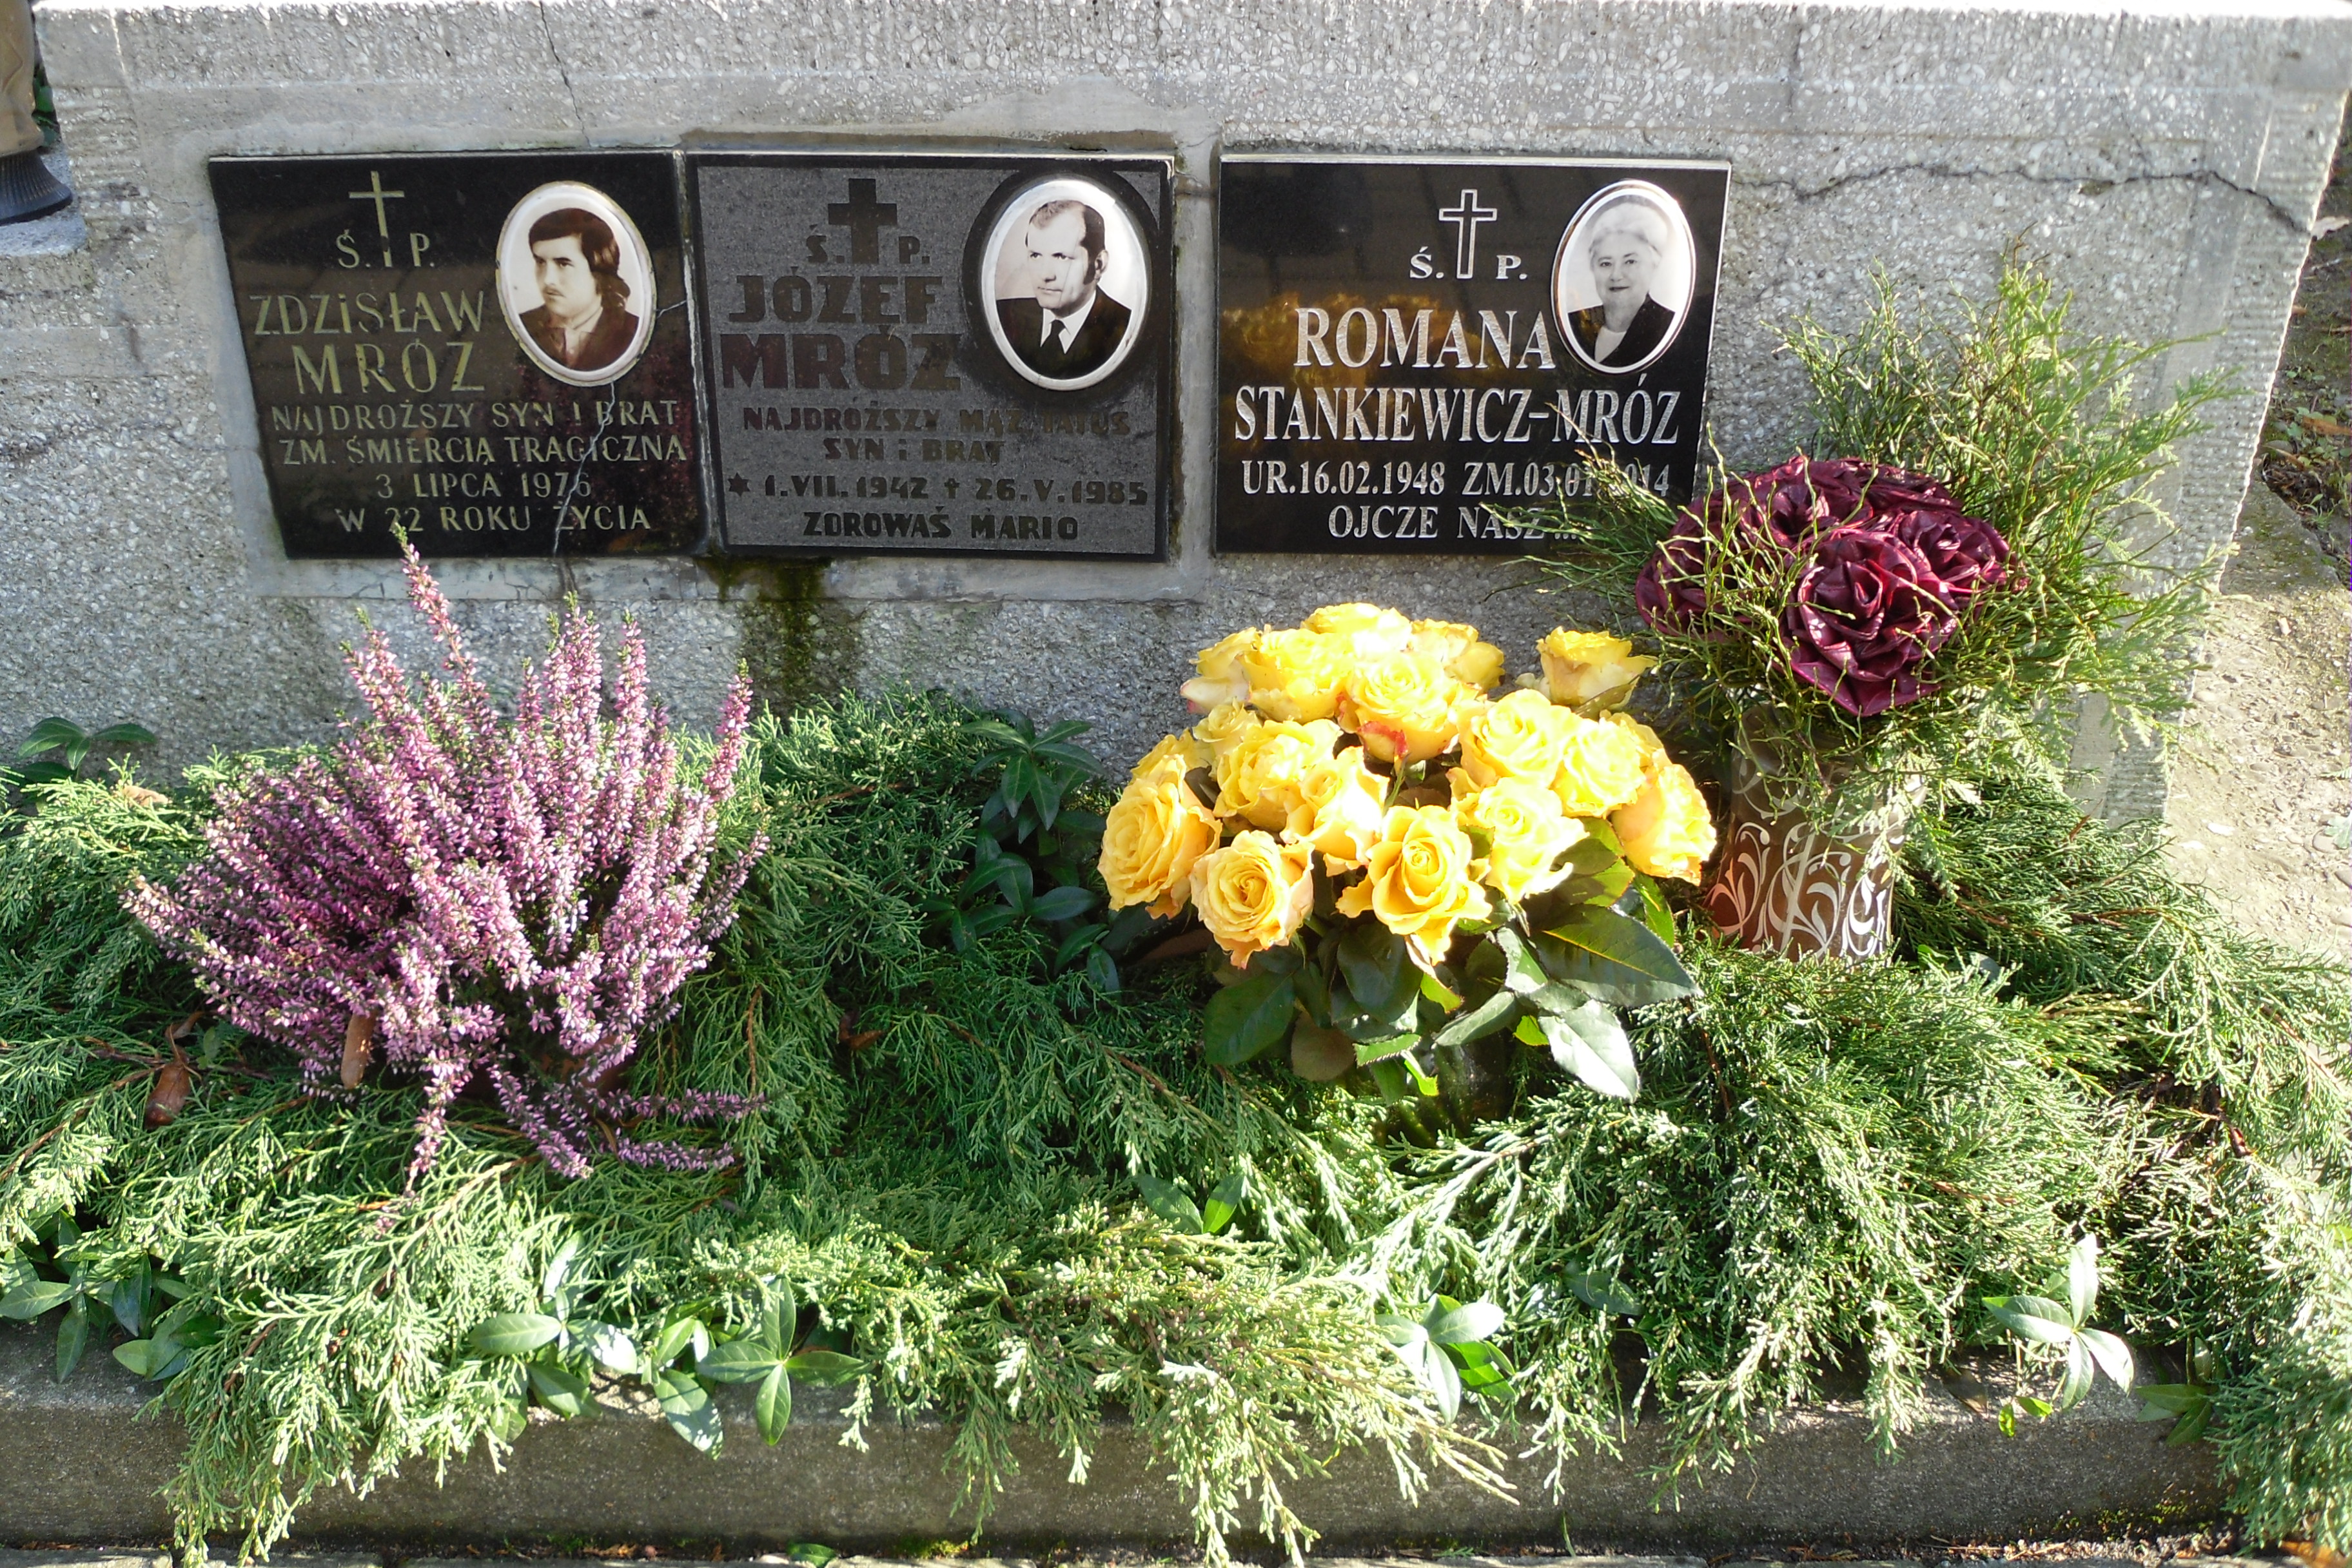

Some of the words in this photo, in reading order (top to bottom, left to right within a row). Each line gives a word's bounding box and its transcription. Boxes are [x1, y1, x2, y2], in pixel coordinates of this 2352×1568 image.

[336, 229, 371, 269] Ś.
[409, 232, 435, 268] P.
[806, 224, 845, 264] Ś.
[898, 235, 930, 264] P.
[1409, 246, 1444, 280] Ś.
[1495, 255, 1528, 280] P.
[729, 266, 943, 324] JÓZEF
[720, 324, 963, 390] MRÓZ
[1293, 307, 1557, 369] ROMANA
[291, 338, 485, 395] MRÓZ
[271, 398, 475, 436] NAJDROŻSZY
[492, 402, 554, 427] SYN
[596, 399, 678, 426] BRAT
[1234, 373, 1681, 444] STANKIEWICZ-MRÓZ
[279, 438, 337, 465] ZM.
[823, 437, 885, 461] SYN
[922, 438, 1005, 463] BRAT
[375, 474, 393, 499] 3
[413, 472, 502, 498] LIPCA
[521, 472, 592, 498] 1976
[335, 507, 366, 533] W
[384, 507, 424, 533] 22
[439, 505, 531, 532] ROKU
[553, 500, 651, 531] ŻYCIA
[970, 514, 1079, 540] MARIO
[1328, 504, 1439, 539] OJCZE
